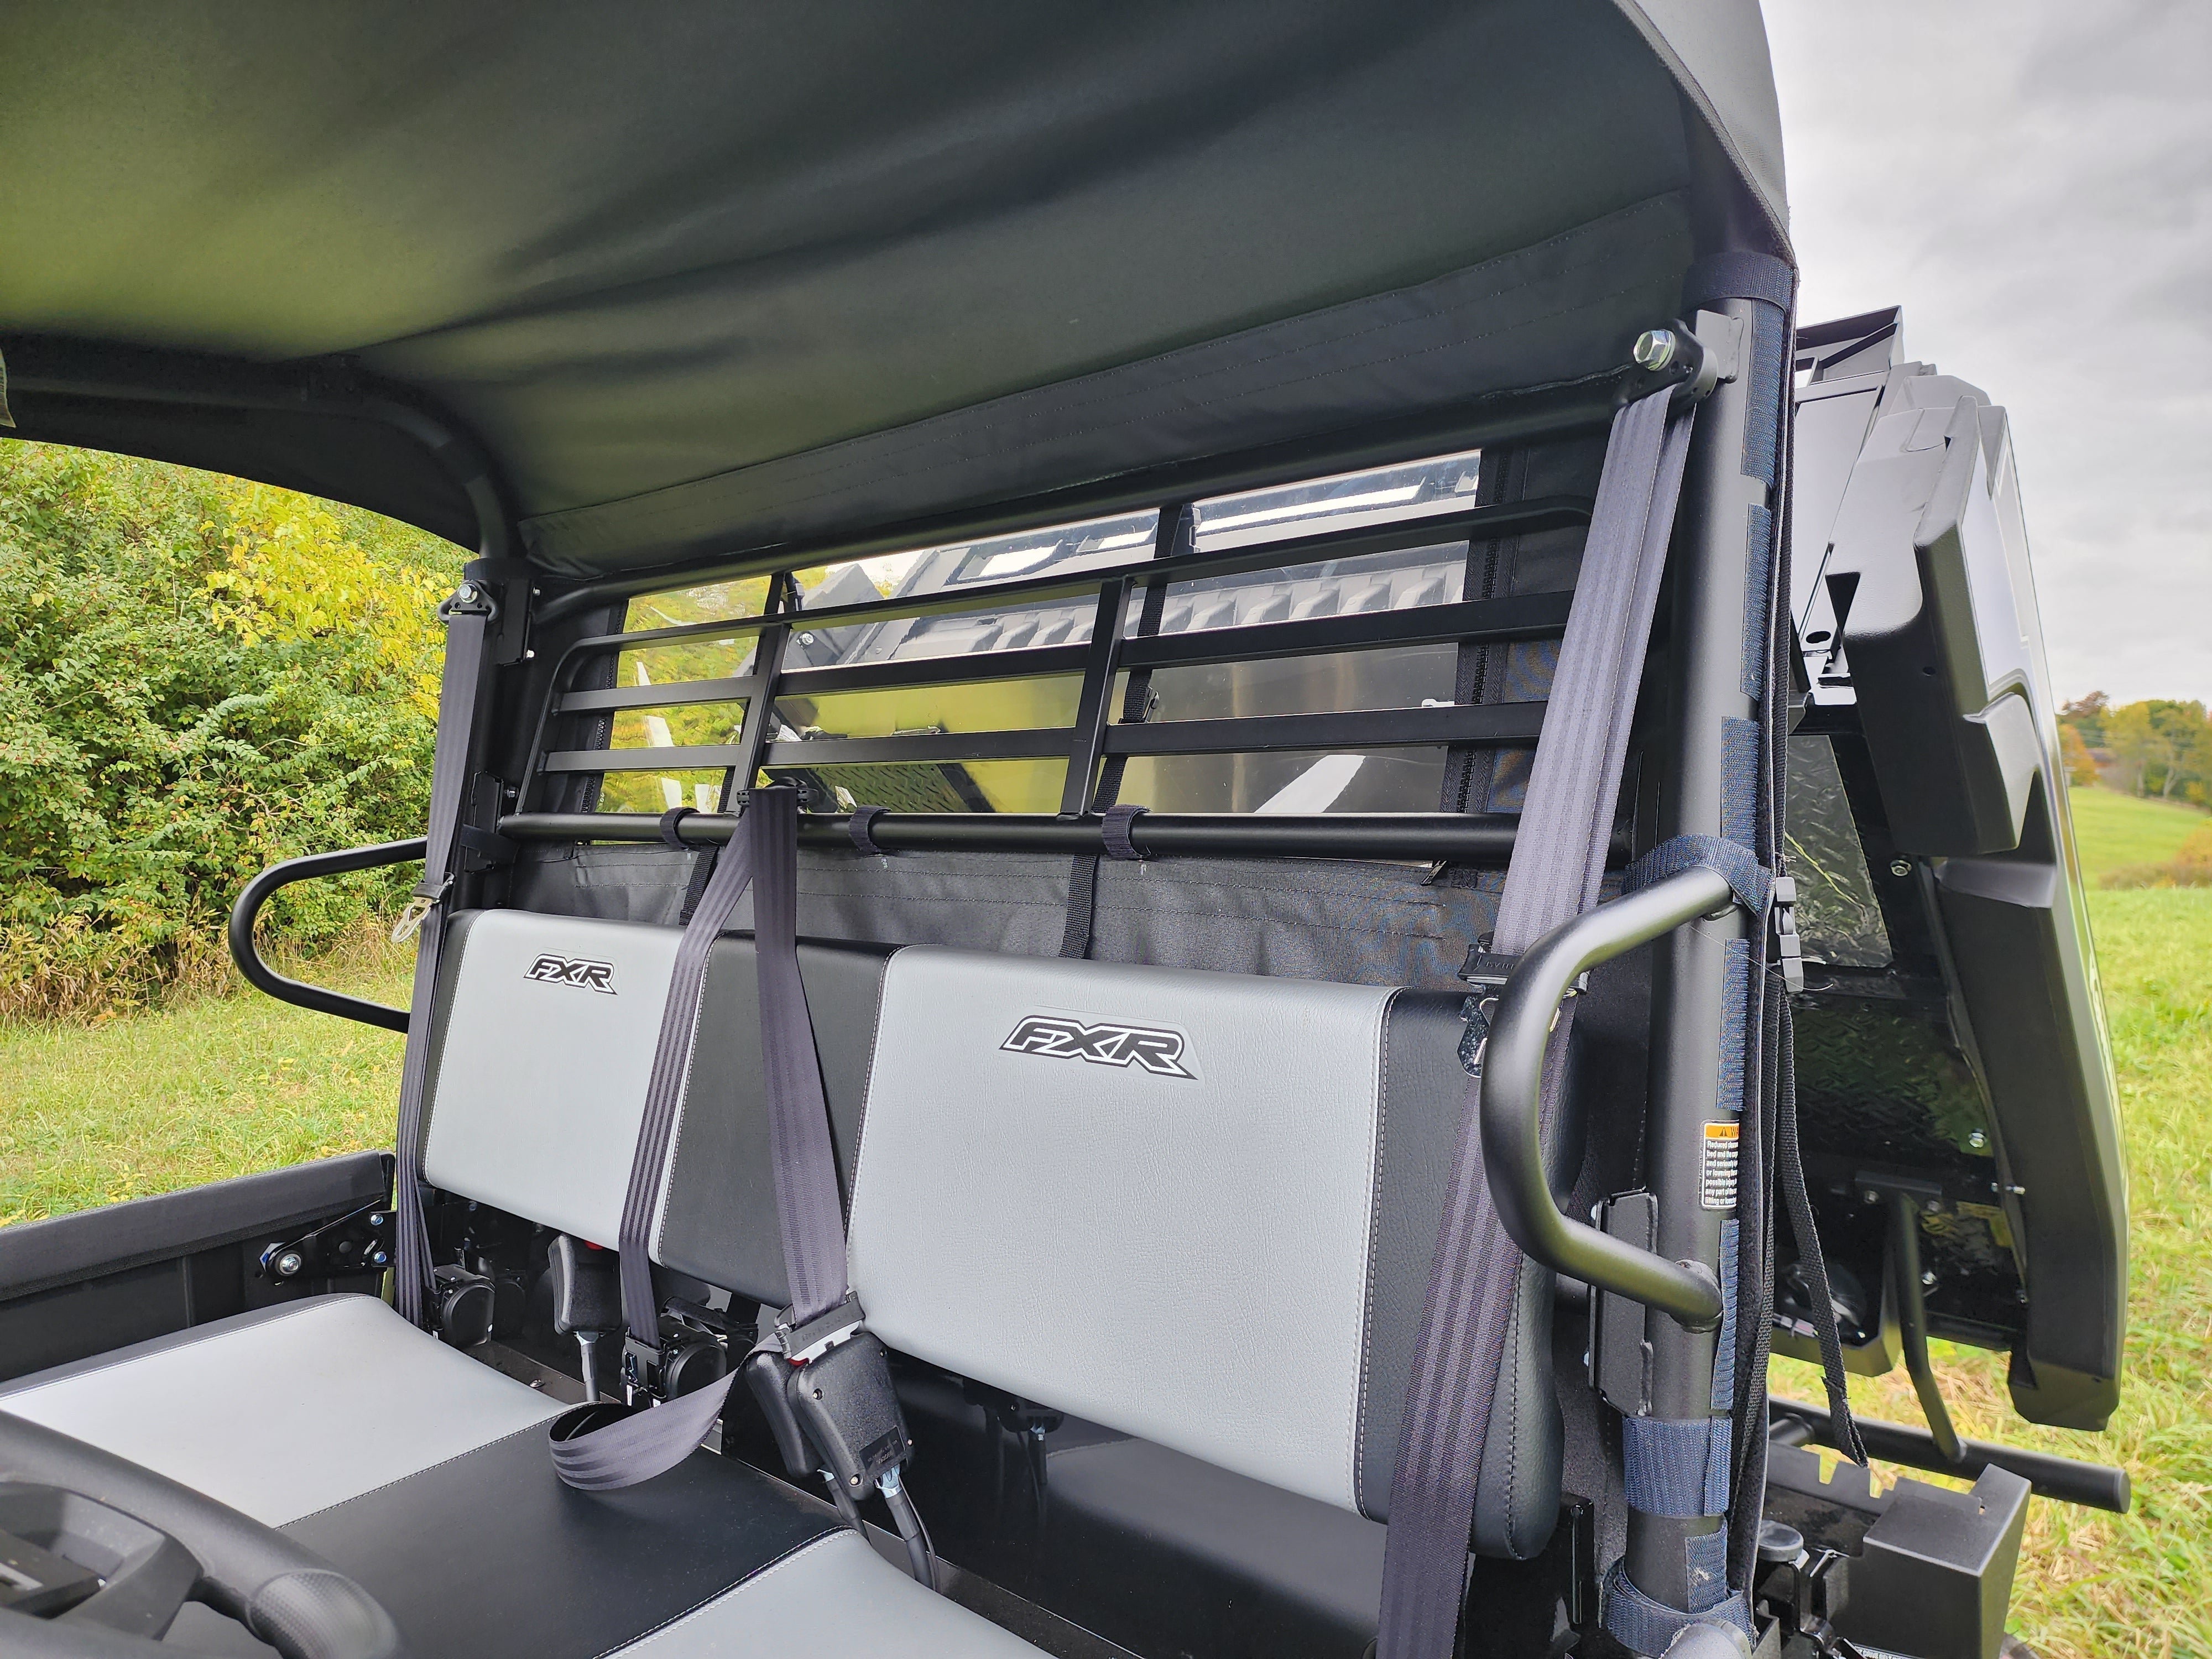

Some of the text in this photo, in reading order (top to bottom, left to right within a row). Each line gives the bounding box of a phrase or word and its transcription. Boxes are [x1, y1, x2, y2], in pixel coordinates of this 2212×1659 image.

[523, 953, 618, 995] FXR
[999, 1015, 1198, 1080] FXR
[1713, 1169, 1730, 1178] lowering
[1705, 1178, 1725, 1187] possible
[1705, 1188, 1715, 1197] any
[1715, 1188, 1724, 1197] part
